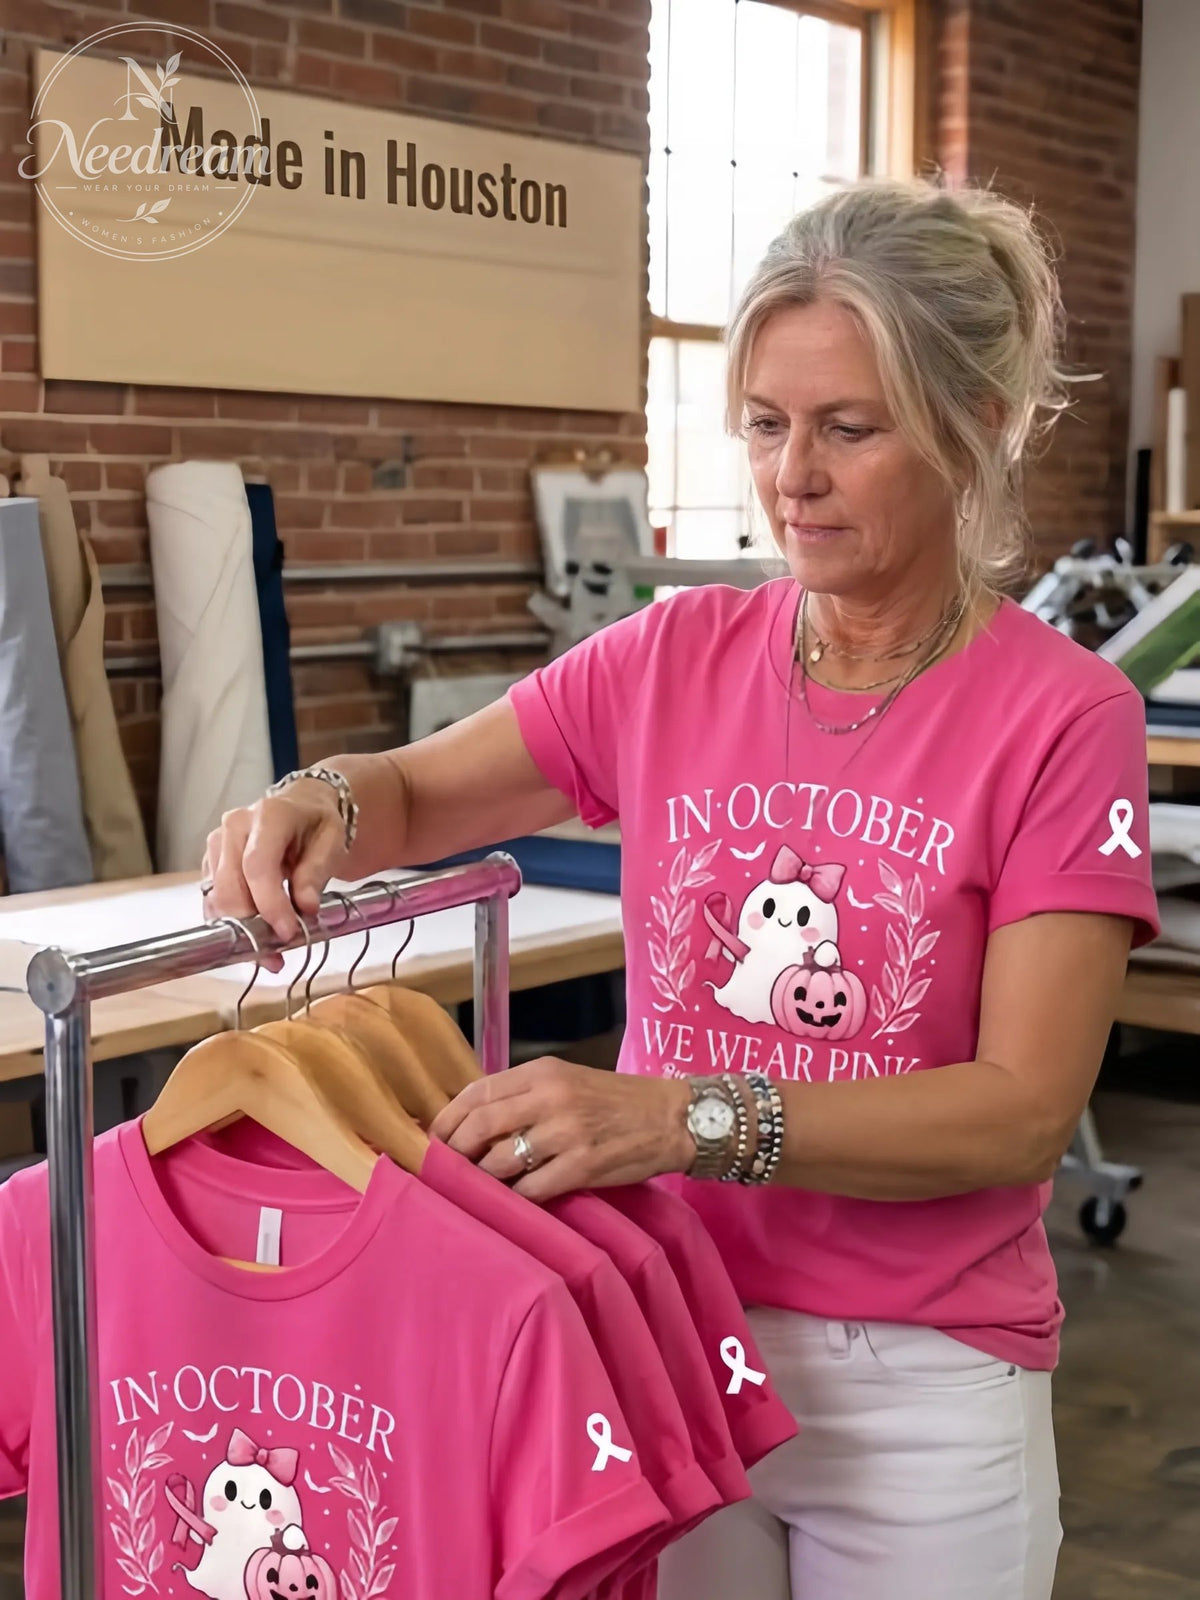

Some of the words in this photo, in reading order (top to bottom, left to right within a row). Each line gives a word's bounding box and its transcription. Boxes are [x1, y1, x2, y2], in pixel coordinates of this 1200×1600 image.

[160, 101, 303, 190] Made
[324, 130, 366, 200] in
[387, 139, 568, 228] Houston
[666, 789, 714, 843] IN
[727, 781, 955, 875] OCTOBER
[641, 1017, 695, 1062] WE
[706, 1029, 814, 1082] WEAR
[109, 1370, 160, 1426] IN
[173, 1365, 396, 1462] OCTOBER
